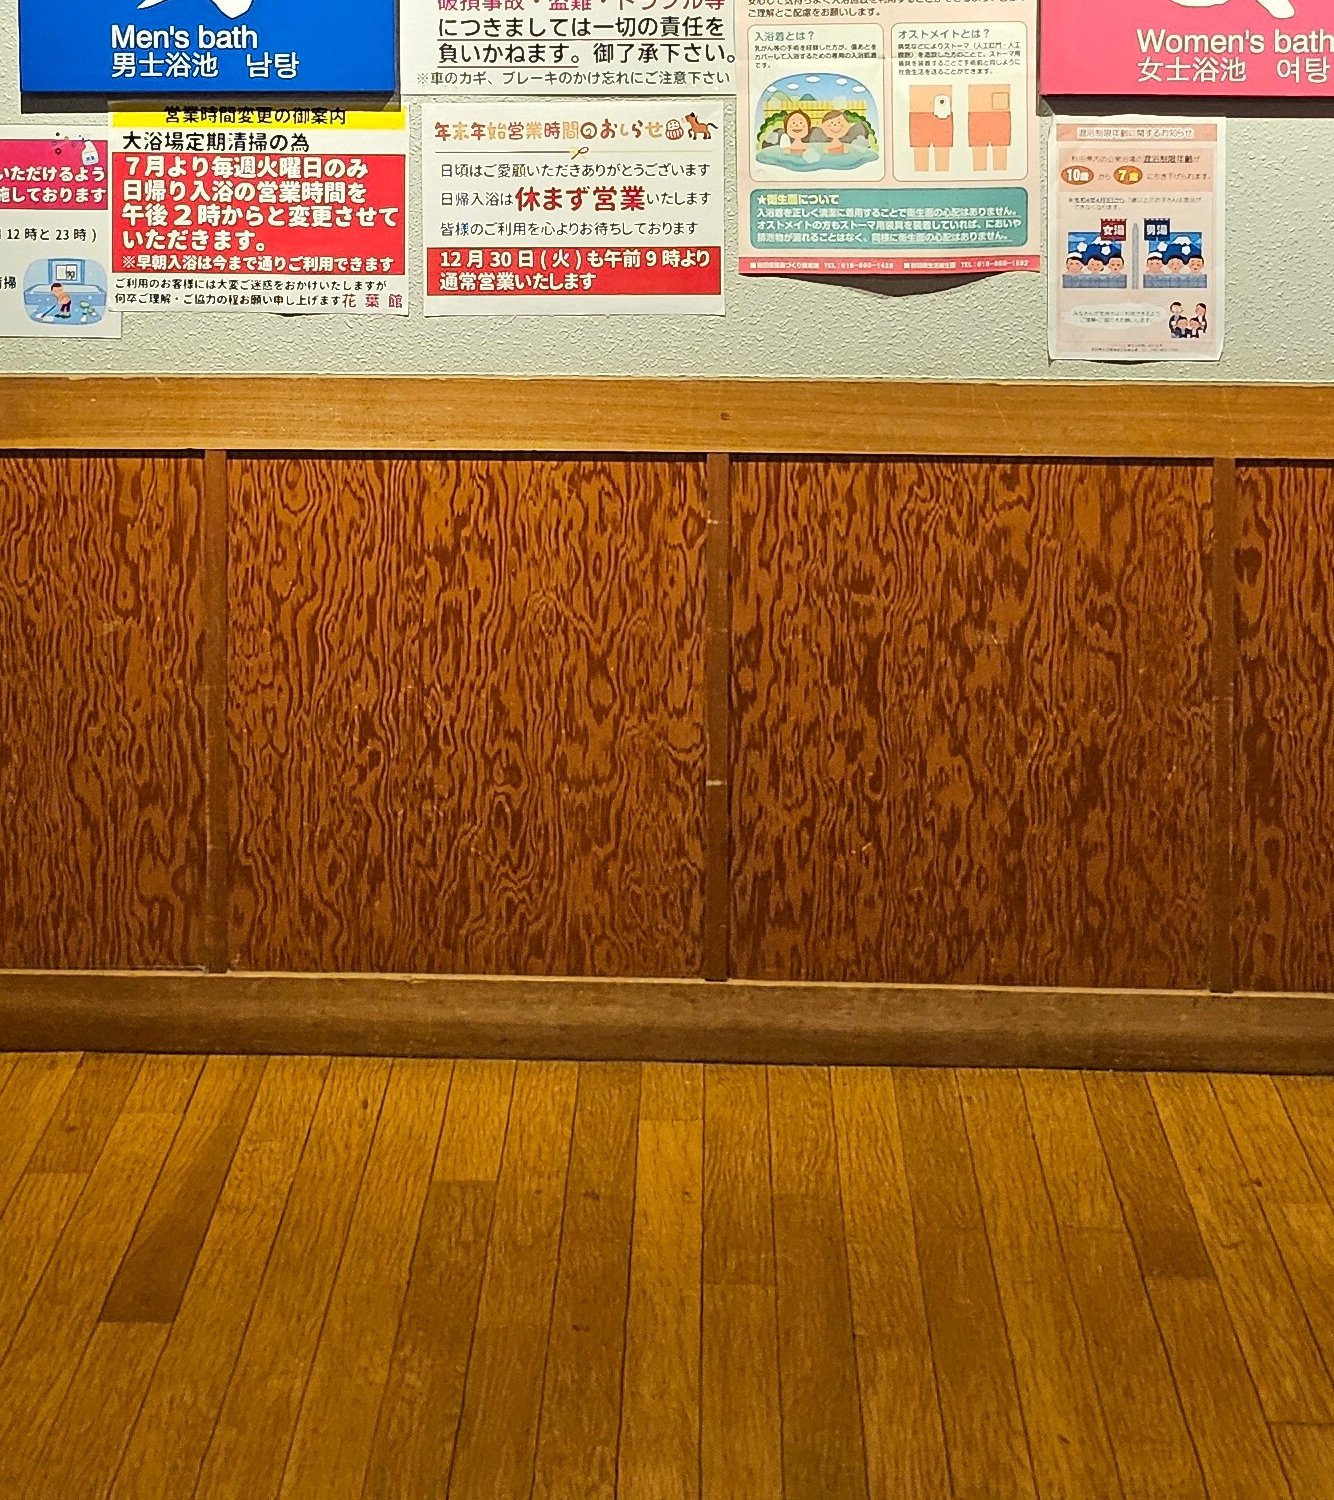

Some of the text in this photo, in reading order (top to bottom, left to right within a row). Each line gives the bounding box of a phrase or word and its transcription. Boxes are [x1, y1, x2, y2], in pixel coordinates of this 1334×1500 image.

[111, 24, 258, 51] Men's bath
[439, 17, 725, 38] につきましては一切の責任を
[755, 32, 814, 41] 入浴着とは？
[898, 29, 989, 39] オストメイトとは？
[1136, 28, 1265, 55] Women's
[439, 43, 735, 64] 負いかねます。御了承下さい。
[111, 52, 219, 79] 男士浴池
[246, 52, 300, 79] 남탕
[1137, 57, 1247, 83] 女士浴池
[1276, 57, 1331, 83] 여탕
[164, 106, 346, 125] 営業時間変更の御案内
[434, 119, 664, 141] 年末年始営業時間のおしらせ
[123, 132, 309, 152] 大浴場定期清掃の為
[125, 156, 369, 178] 7月より毎週火曜日のみ
[440, 163, 710, 178] 日頃はご愛顧いただきありがとうございます
[123, 180, 367, 204] 日帰り入浴の営業時間を
[440, 185, 712, 212] 日帰入浴は休まず営業いたします
[122, 205, 399, 227] 午後2時からと変更させて
[440, 221, 699, 236] 皆様のご利用を心よりお待ちしております
[122, 229, 265, 251] いただきます。
[115, 278, 387, 290] ご利用のお客様には大変ご迷惑をおかけいたしますが
[439, 272, 596, 291] 通常営業いたします
[115, 292, 341, 306] 何卒ご理解・ご協力の程お願い申し上げます
